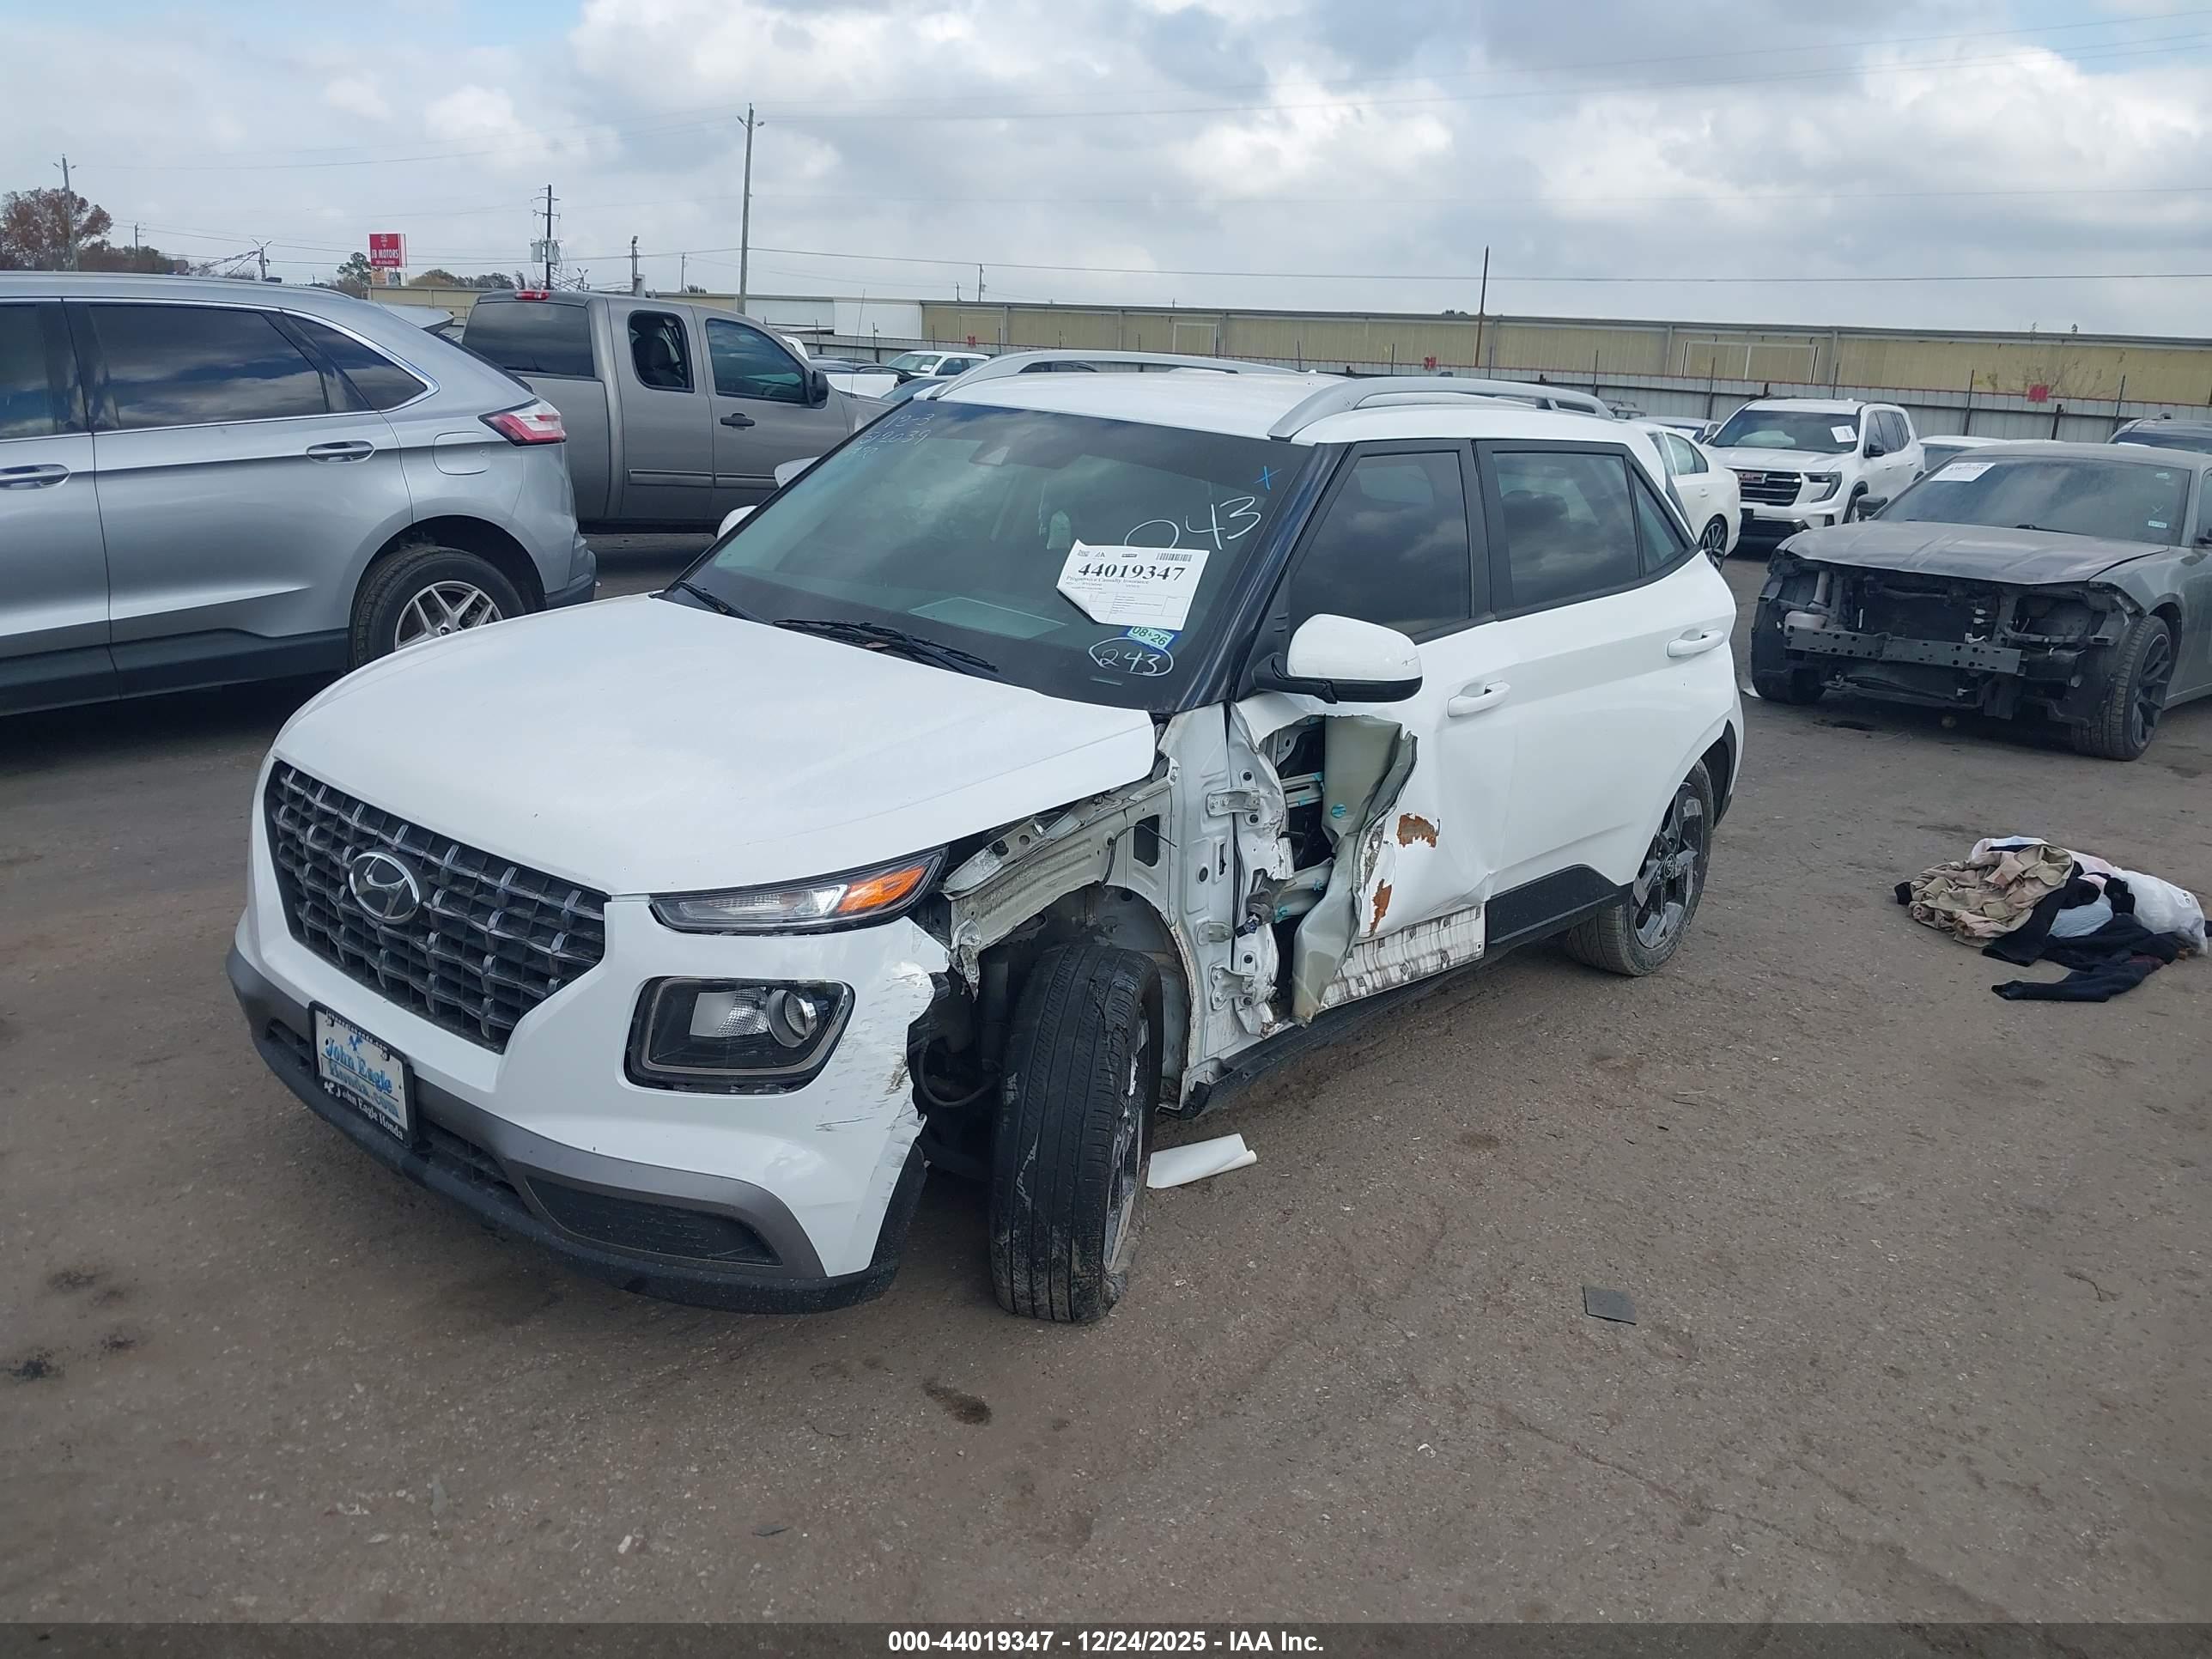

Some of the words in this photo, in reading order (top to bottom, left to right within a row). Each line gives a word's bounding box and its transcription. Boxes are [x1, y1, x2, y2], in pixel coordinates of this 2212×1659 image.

[378, 248, 398, 259] MOTORS
[1078, 562, 1187, 581] 44019347
[1133, 626, 1149, 637] 08
[1151, 634, 1168, 646] 26
[1100, 648, 1161, 674] 243
[325, 1037, 356, 1071] John
[357, 1056, 392, 1094] Eagle
[336, 1085, 357, 1106] John
[358, 1098, 379, 1121] Eagle
[380, 1113, 404, 1141] Honda
